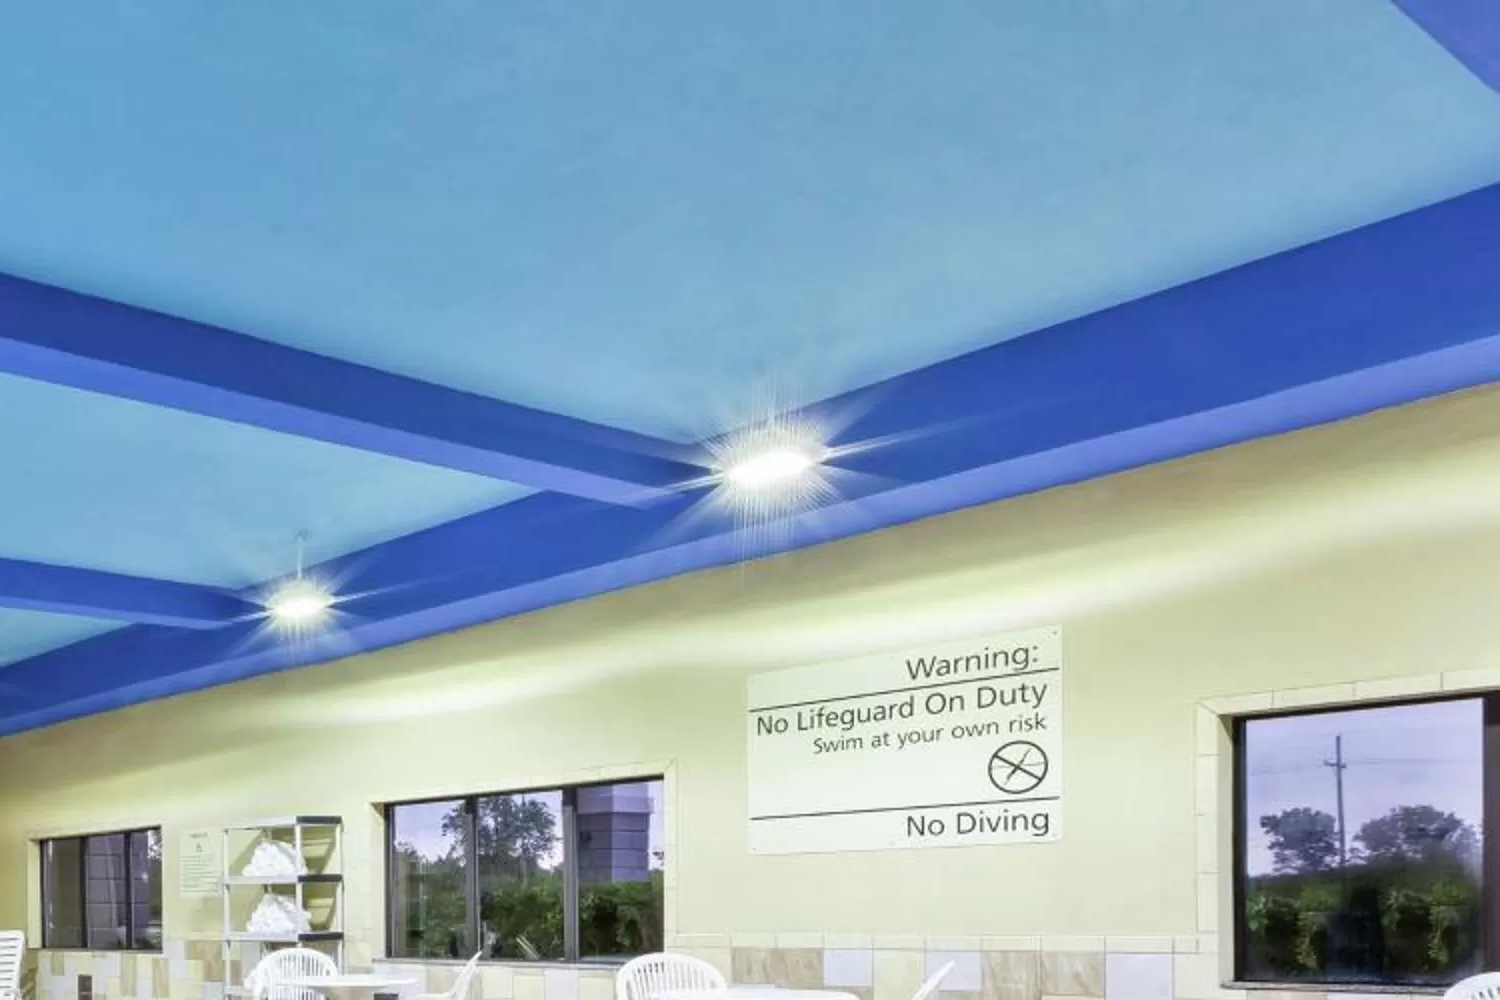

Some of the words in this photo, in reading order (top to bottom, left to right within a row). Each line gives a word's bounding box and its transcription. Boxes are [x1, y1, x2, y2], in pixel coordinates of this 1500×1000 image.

[906, 646, 1038, 680] Warning:
[758, 716, 788, 736] No
[798, 696, 914, 731] Lifeguard
[925, 693, 964, 714] On
[977, 683, 1047, 709] Duty
[814, 736, 863, 754] Swim
[872, 733, 889, 748] at
[898, 728, 943, 749] your
[952, 722, 999, 738] own
[1009, 712, 1046, 732] risk
[908, 816, 944, 836] No
[957, 809, 1049, 836] Diving
